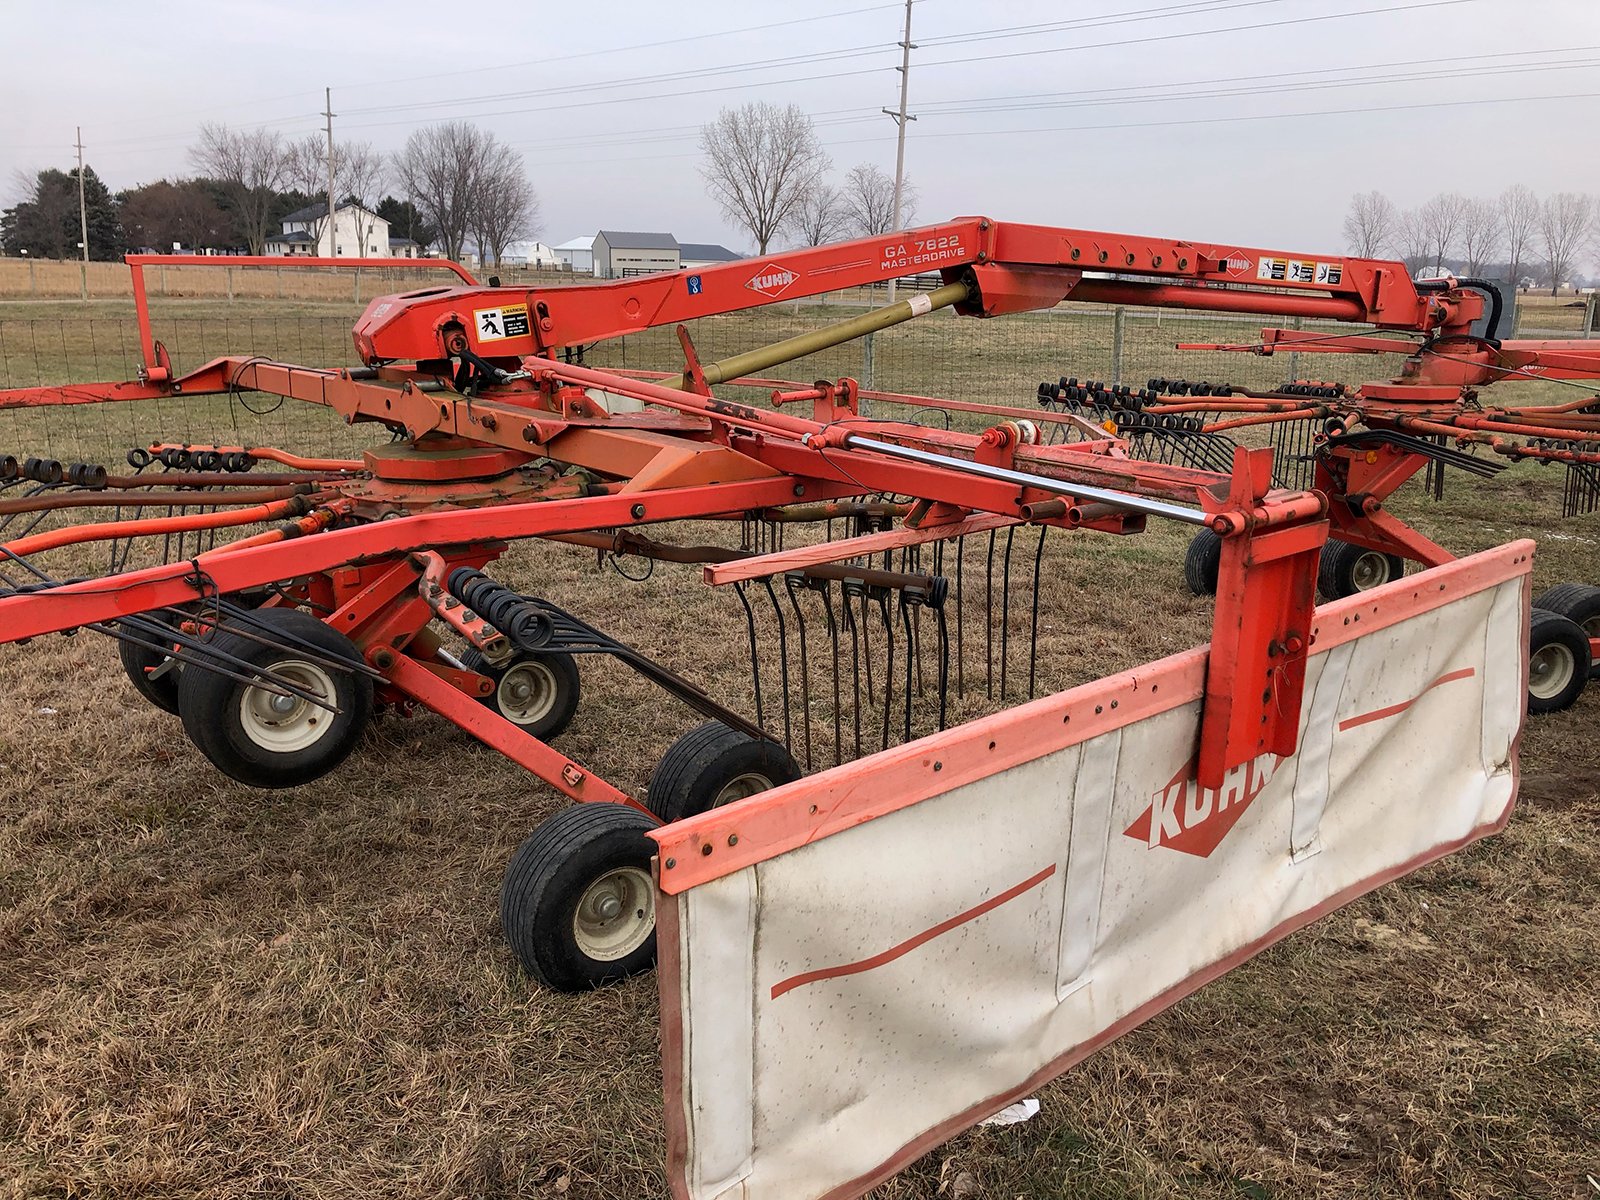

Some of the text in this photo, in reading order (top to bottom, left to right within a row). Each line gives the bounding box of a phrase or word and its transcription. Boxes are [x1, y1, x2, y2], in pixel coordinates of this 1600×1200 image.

[885, 235, 959, 258] GA 7822
[881, 247, 965, 270] MASTERDRIVE
[752, 270, 793, 290] KUHN
